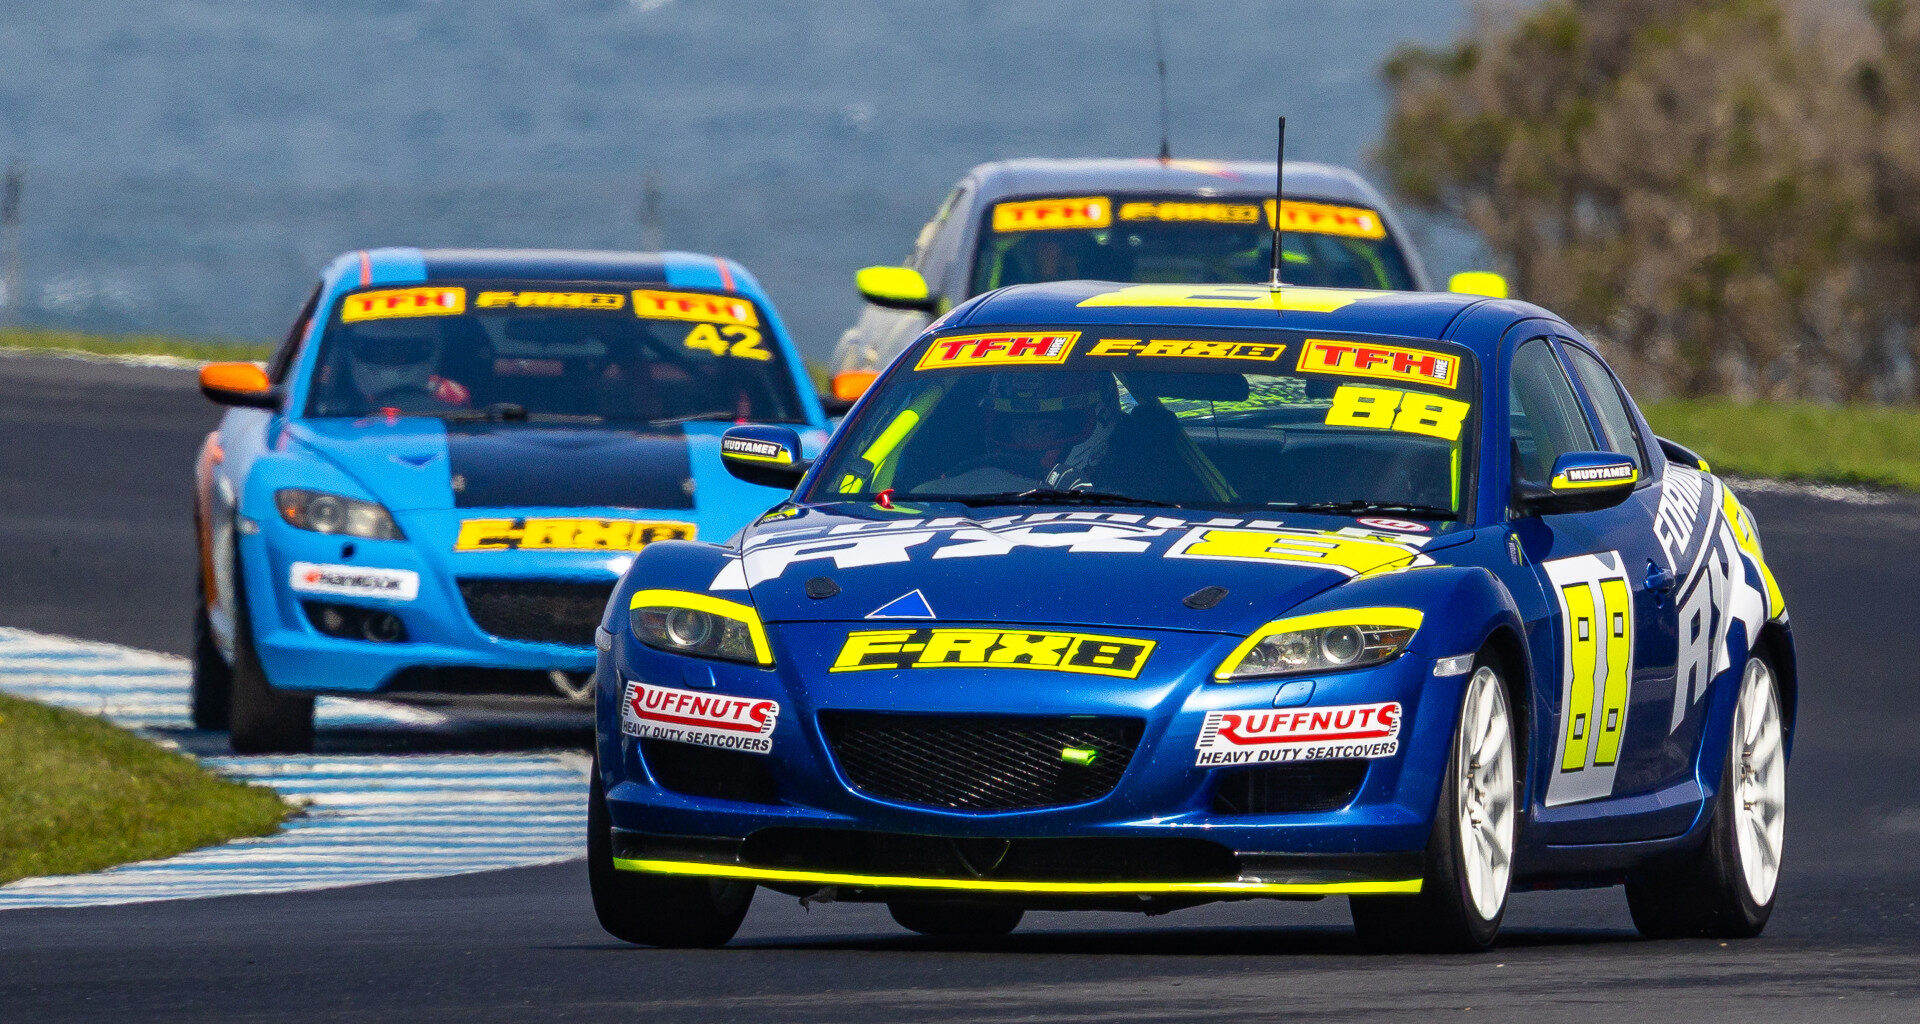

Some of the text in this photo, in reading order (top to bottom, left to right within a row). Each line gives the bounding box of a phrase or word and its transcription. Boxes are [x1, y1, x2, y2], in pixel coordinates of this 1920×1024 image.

[684, 323, 773, 361] 42
[940, 336, 1067, 361] TFH HIRE
[1086, 338, 1287, 361] F-RX8
[1314, 345, 1449, 380] TFH HIRE
[1325, 386, 1471, 441] 88
[723, 440, 777, 456] MUDTAMER
[1570, 466, 1632, 481] MUDTAMER
[828, 628, 1157, 680] F-RX8
[1560, 577, 1630, 773] 88
[631, 685, 774, 733] RUFFNUTS
[1218, 704, 1397, 746] RUFFNUTS
[622, 720, 770, 751] HEAVY DUTY SEATCOVERS
[1199, 741, 1397, 765] HEAVY DUTY SEATCOVERS
